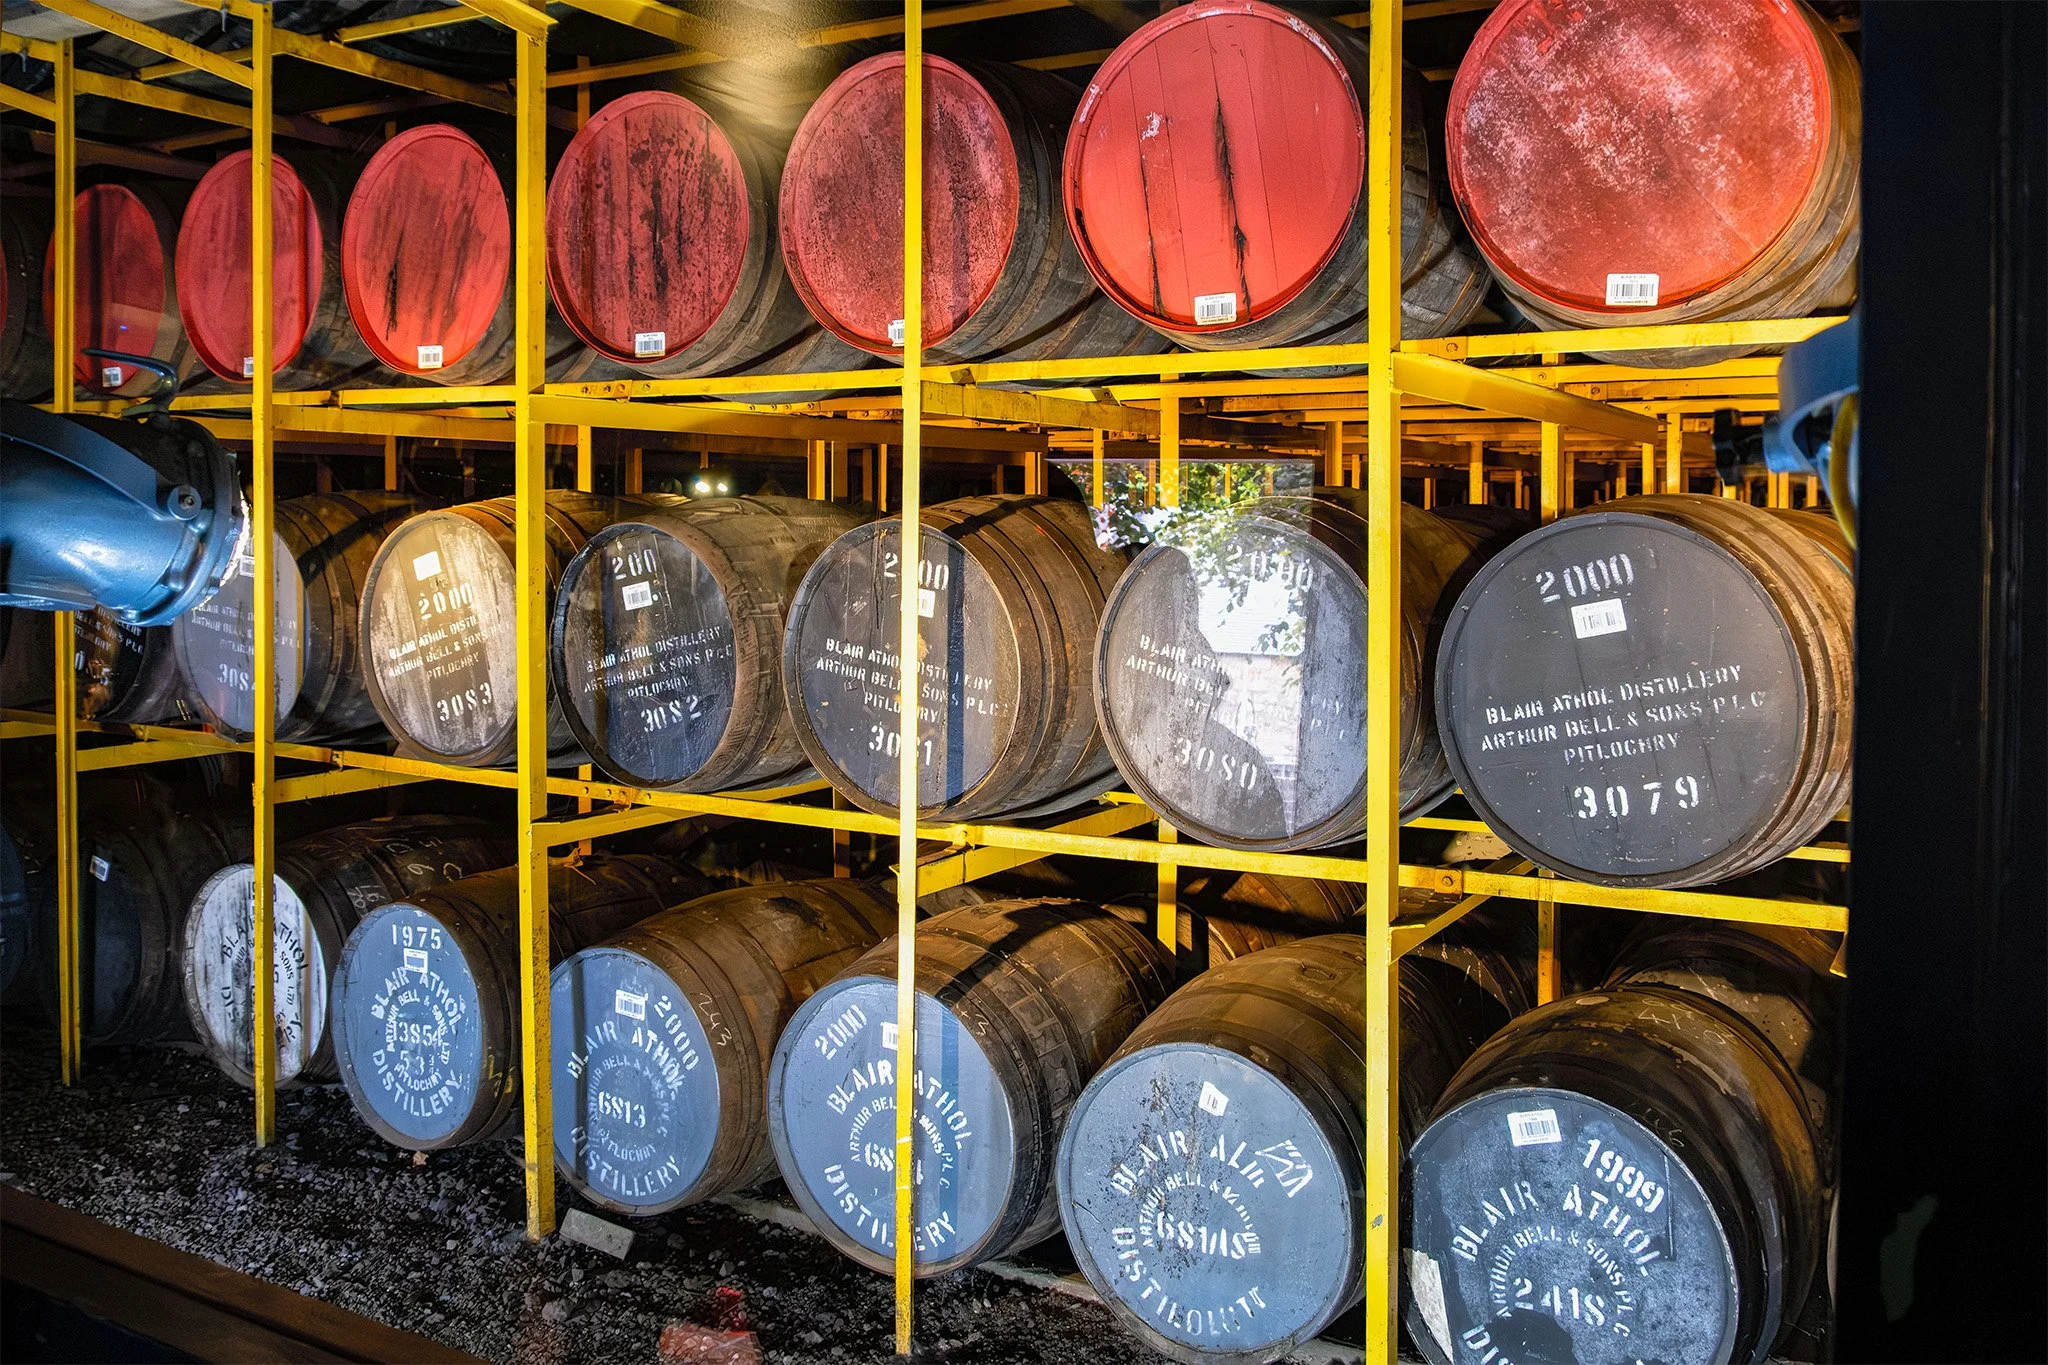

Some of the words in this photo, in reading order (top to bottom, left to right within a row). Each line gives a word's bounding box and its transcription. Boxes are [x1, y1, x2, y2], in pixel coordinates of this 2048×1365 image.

[884, 552, 949, 591] 200
[1535, 553, 1634, 603] 2000
[418, 582, 473, 620] 2000
[388, 640, 416, 660] BLAIR
[388, 655, 424, 678] ARTHUR
[425, 645, 452, 663] BELL
[454, 641, 461, 652] &
[462, 631, 488, 648] SONS
[426, 652, 479, 679] PITLOCHRY
[587, 653, 616, 673] BLAIR
[620, 645, 653, 663] ATHOL
[655, 626, 720, 653] DISTILLERY
[669, 652, 701, 671] SONS
[826, 638, 864, 660] BLAIR
[868, 649, 900, 669] ATHO
[1125, 655, 1190, 687] ARTHUR
[1140, 634, 1187, 664] BLAIR
[1191, 653, 1230, 676] ATH
[816, 656, 866, 682] ARTHUR
[922, 684, 959, 706] SONS
[1485, 699, 1544, 725] BLAIR
[1552, 686, 1614, 713] ATHOL
[1619, 664, 1741, 702] DISTILLERY
[868, 724, 932, 766] 301
[1481, 724, 1558, 752] ARTHUR
[1565, 714, 1621, 738] BELL
[1645, 700, 1703, 723] SONS
[1563, 731, 1680, 765] PITLOCHRY
[1573, 775, 1699, 820] 3079
[391, 924, 441, 950] 1975
[371, 966, 410, 1019] BLAIR
[419, 971, 462, 1035] ATHOL
[397, 989, 420, 1006] BELL
[566, 1021, 617, 1079] BLAIR
[653, 995, 700, 1071] 2000
[814, 1004, 868, 1060] 2000
[372, 1048, 463, 1117] DISTILLERY
[602, 1054, 631, 1071] BELL
[826, 1059, 894, 1115] BLAIR
[849, 1105, 873, 1162] ARTHUR
[871, 1096, 897, 1113] BEL
[570, 1126, 680, 1197] DISTILLERY
[1110, 1129, 1190, 1197] BLAIR
[1165, 1171, 1206, 1192] BELL
[1580, 1138, 1665, 1213] 1999
[824, 1163, 956, 1251] DISTILERY
[1450, 1180, 1539, 1262] BLAIR
[1562, 1183, 1661, 1278] ATHOL
[1489, 1244, 1517, 1318] ARTHUR
[1512, 1225, 1562, 1249] BELL
[1567, 1230, 1579, 1248] &
[1583, 1239, 1626, 1286] SONS
